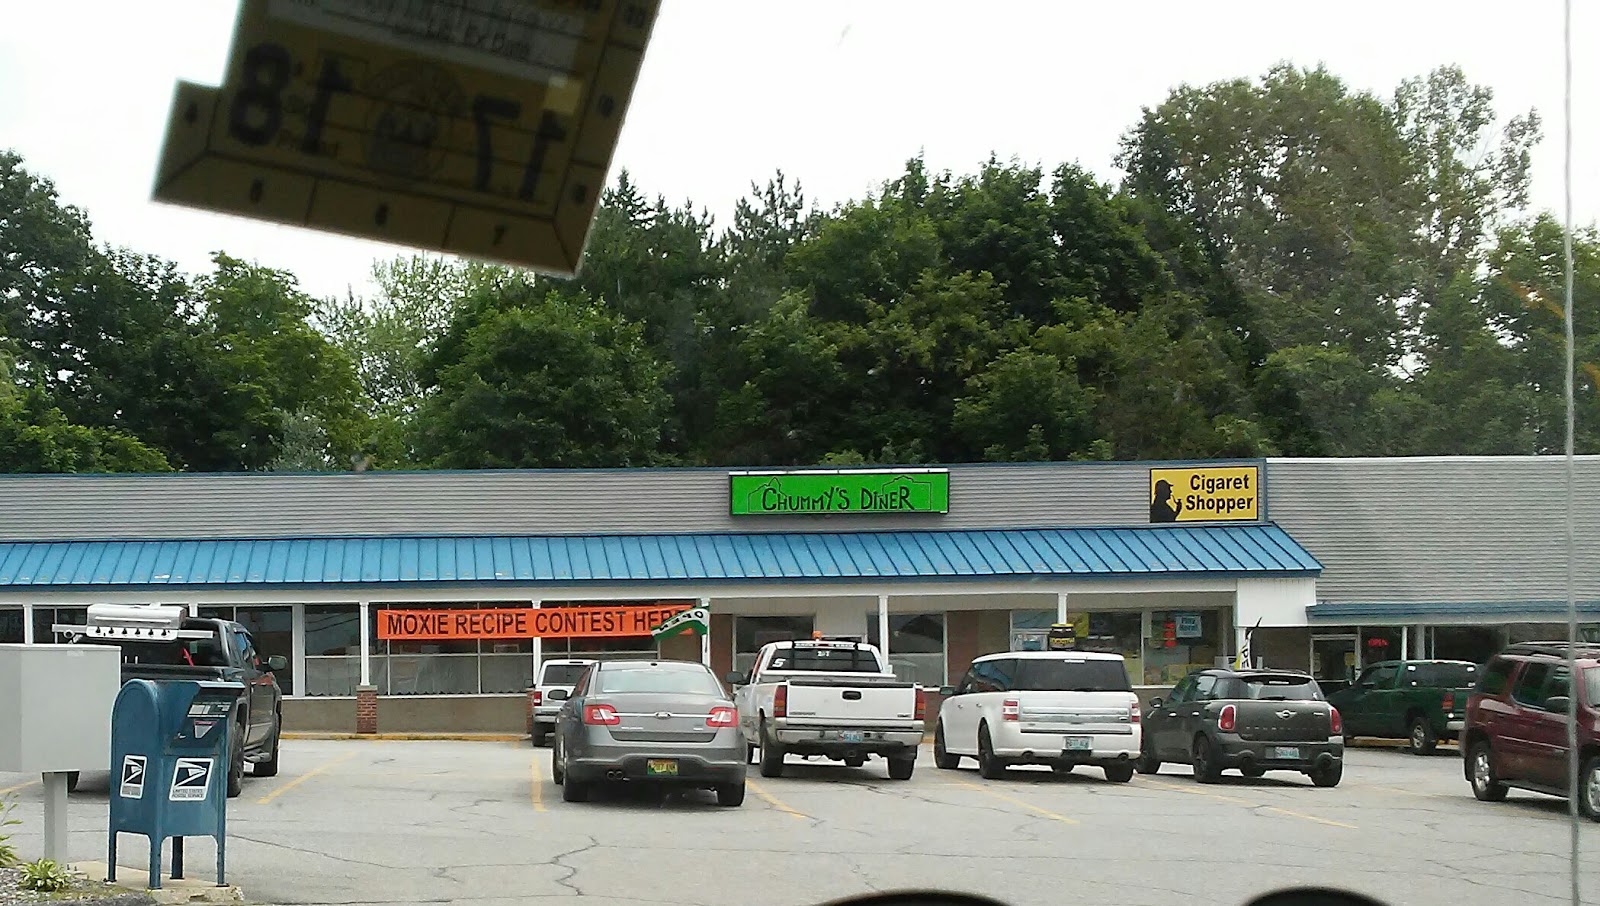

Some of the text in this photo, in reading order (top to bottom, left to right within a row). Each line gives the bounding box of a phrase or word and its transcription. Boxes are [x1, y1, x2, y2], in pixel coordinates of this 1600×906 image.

[1190, 474, 1249, 494] Cigaret
[762, 486, 850, 511] CHUMMY'S
[1186, 494, 1253, 514] Shopper
[387, 610, 686, 635] MOXIE RECIPE CONTEST HER
